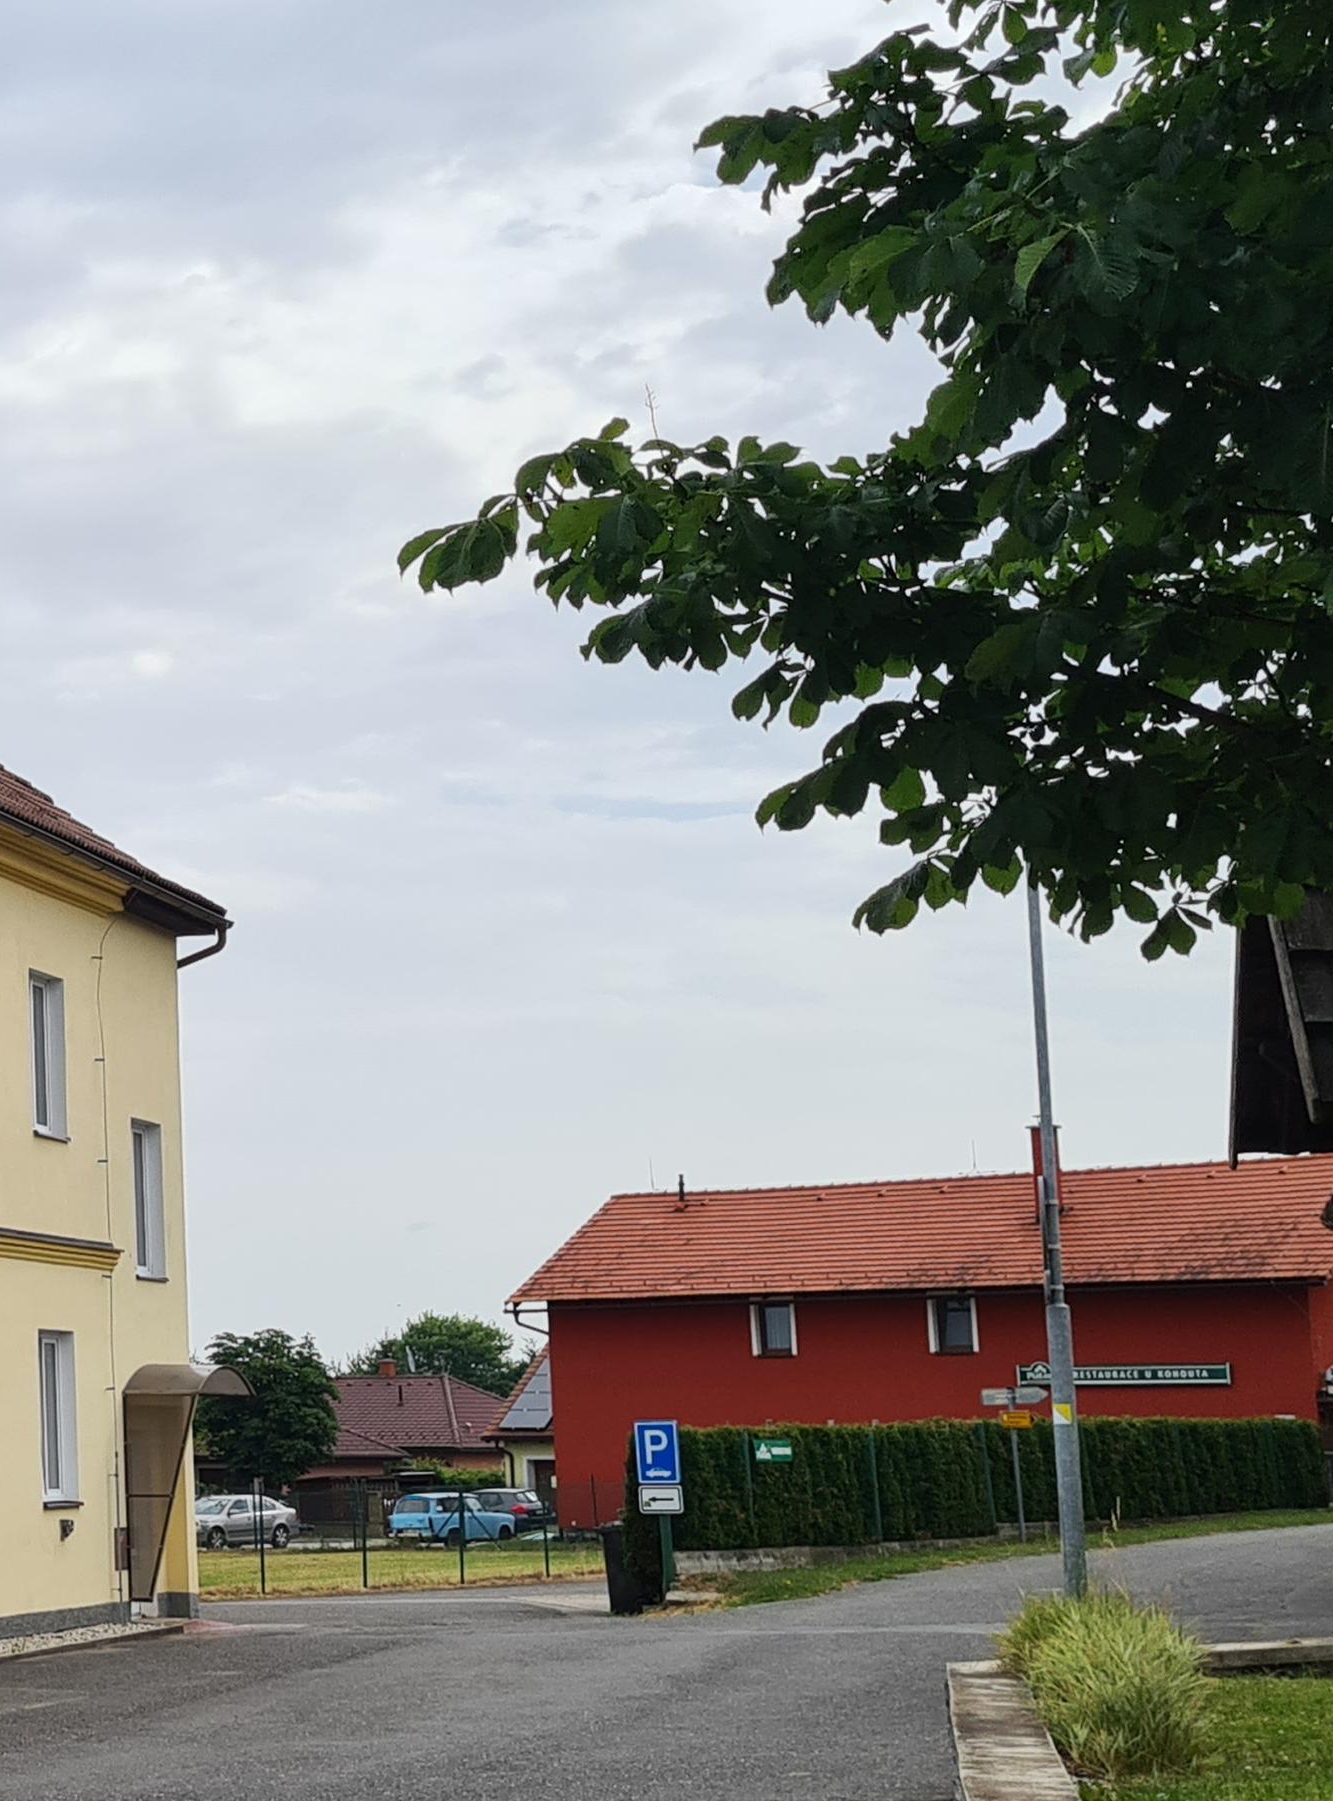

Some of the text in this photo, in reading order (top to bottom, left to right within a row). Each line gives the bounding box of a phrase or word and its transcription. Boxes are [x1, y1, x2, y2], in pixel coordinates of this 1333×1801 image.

[1073, 1369, 1209, 1380] RESTAURACE U KOHOUTA
[644, 1429, 668, 1465] P
